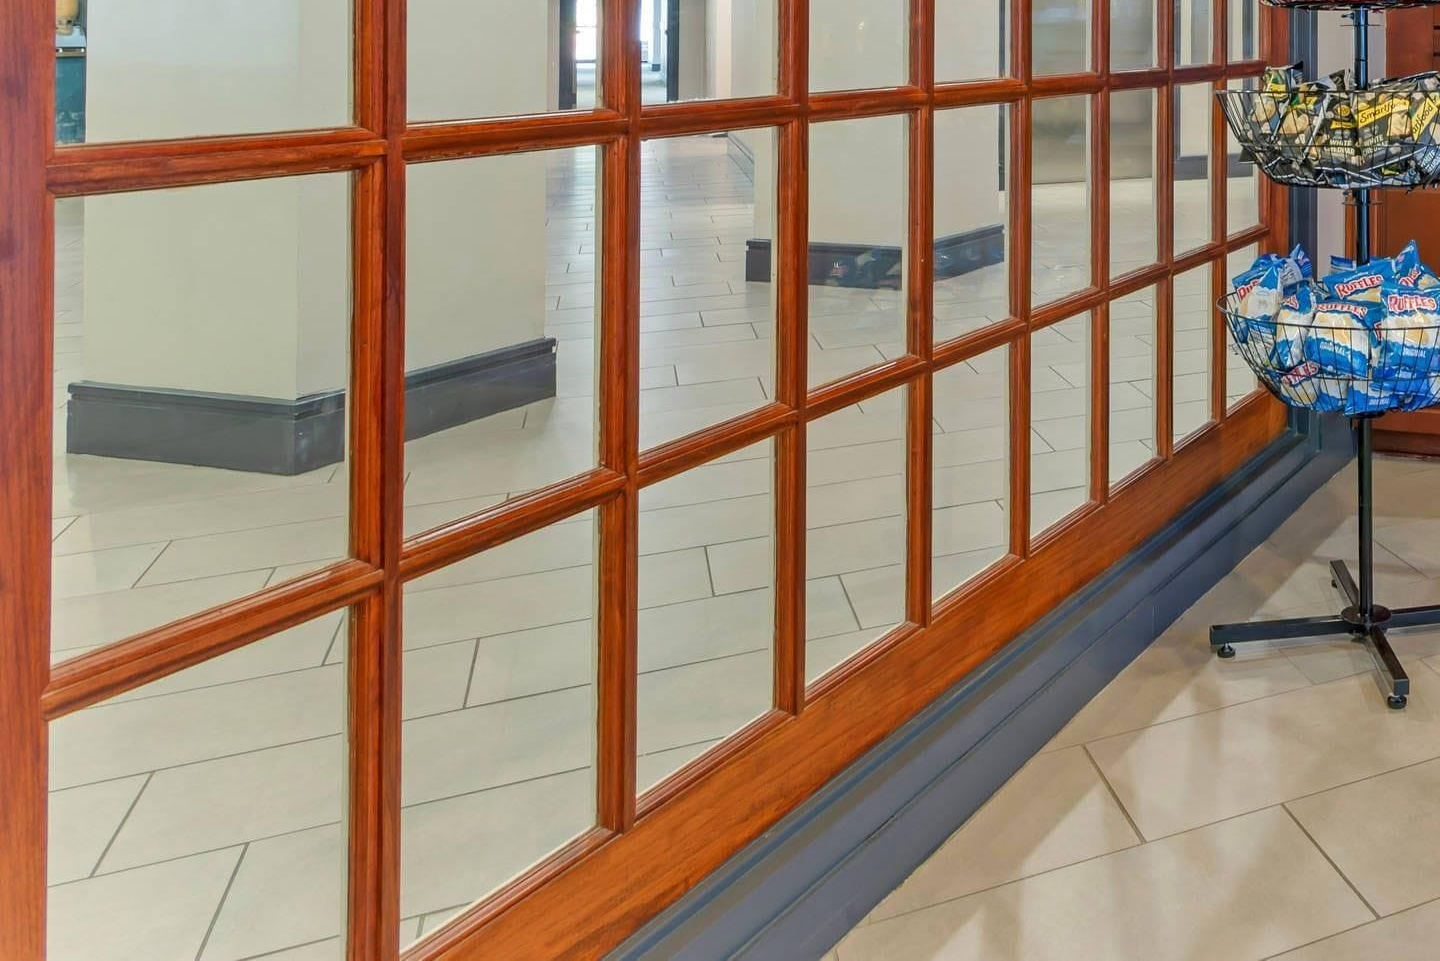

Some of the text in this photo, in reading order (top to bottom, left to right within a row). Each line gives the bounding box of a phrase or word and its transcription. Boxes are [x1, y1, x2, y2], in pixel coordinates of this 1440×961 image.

[1329, 139, 1352, 147] WHITE
[1363, 135, 1384, 147] WHITE
[1335, 275, 1384, 299] RUFFLES
[1316, 303, 1369, 318] RUFFLES
[1388, 294, 1438, 313] RUFFLES
